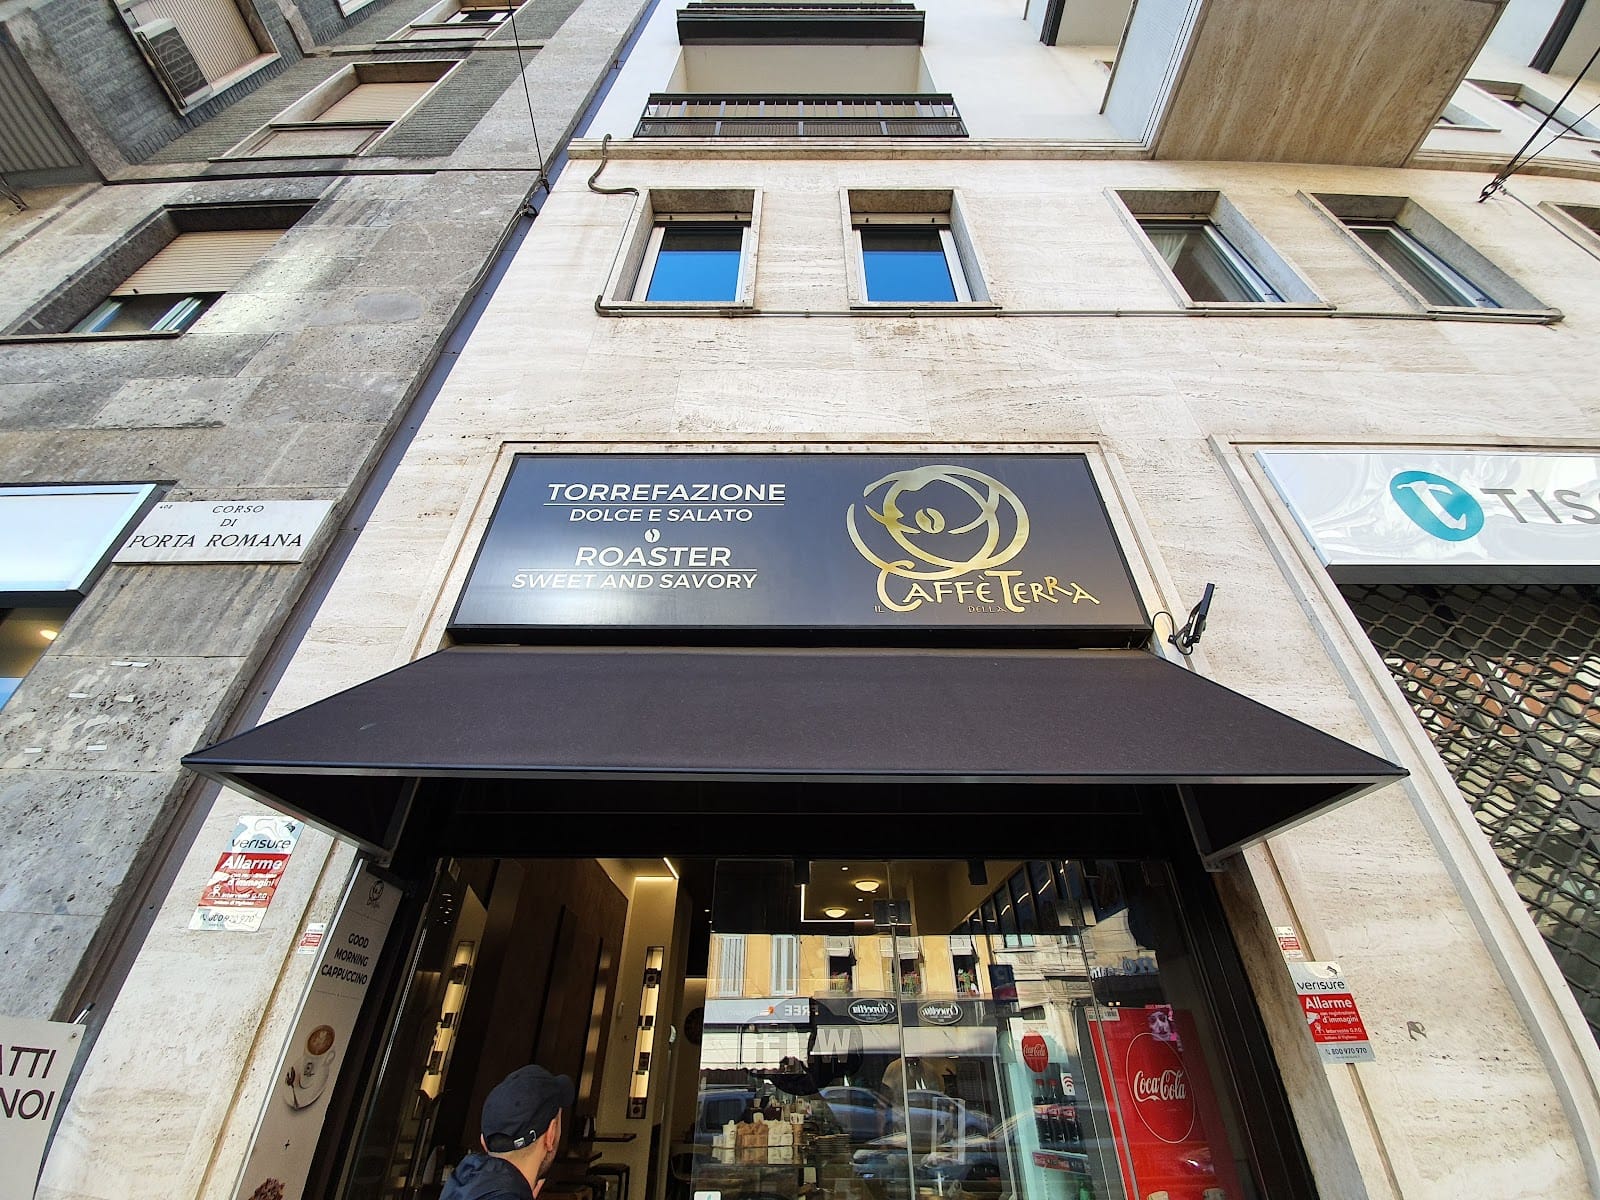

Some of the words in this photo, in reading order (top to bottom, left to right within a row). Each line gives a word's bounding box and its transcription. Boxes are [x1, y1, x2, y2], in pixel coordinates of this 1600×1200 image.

[548, 483, 786, 501] TORREFAZIONE
[212, 505, 265, 514] CORSO
[1480, 488, 1600, 525] TIS
[220, 518, 238, 527] DI
[569, 508, 642, 522] DOLCE
[648, 508, 662, 522] E
[667, 508, 753, 522] SALATO
[128, 534, 196, 548] PORTA
[206, 533, 302, 548] ROMANA
[575, 547, 732, 567] ROASTER
[511, 574, 597, 589] SWEET
[600, 574, 654, 589] AND
[659, 573, 759, 589] SAVORY
[984, 570, 1101, 613] TERRA
[231, 839, 291, 849] verisure
[220, 854, 283, 870] Allarme
[348, 933, 370, 949] GOOD
[333, 947, 369, 968] MORNING
[321, 964, 368, 986] CAPPUCCINO
[1296, 981, 1345, 990] verisure
[1305, 996, 1353, 1010] Allarme
[0, 1044, 56, 1079] TTI
[1133, 1069, 1187, 1103] Coca-Cola
